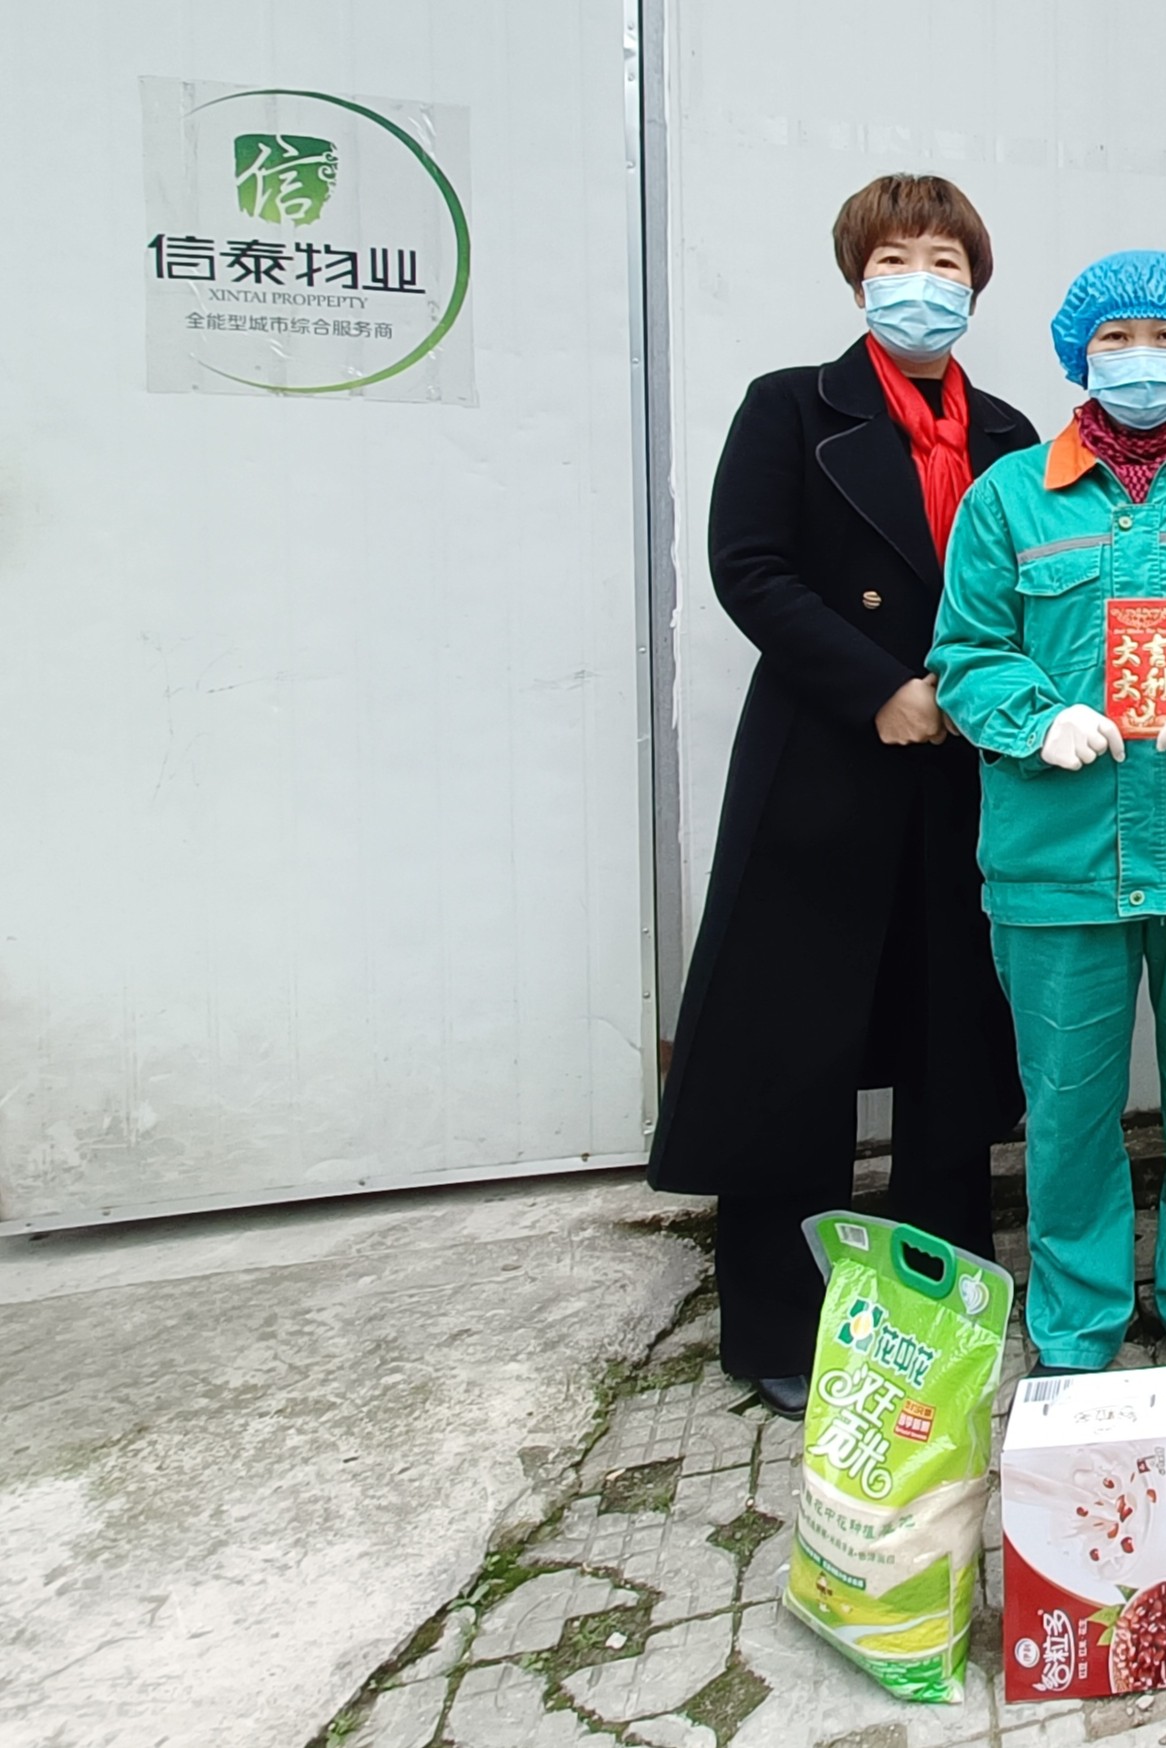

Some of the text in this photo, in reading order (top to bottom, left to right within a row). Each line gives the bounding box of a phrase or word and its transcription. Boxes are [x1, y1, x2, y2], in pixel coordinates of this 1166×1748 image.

[235, 134, 338, 222] 信
[147, 233, 426, 294] 信泰物业
[185, 311, 393, 340] 全能型城市综合服务商
[208, 288, 267, 304] XINTAI
[874, 1325, 934, 1387] 花中花
[1040, 1609, 1069, 1689] 谷粒多
